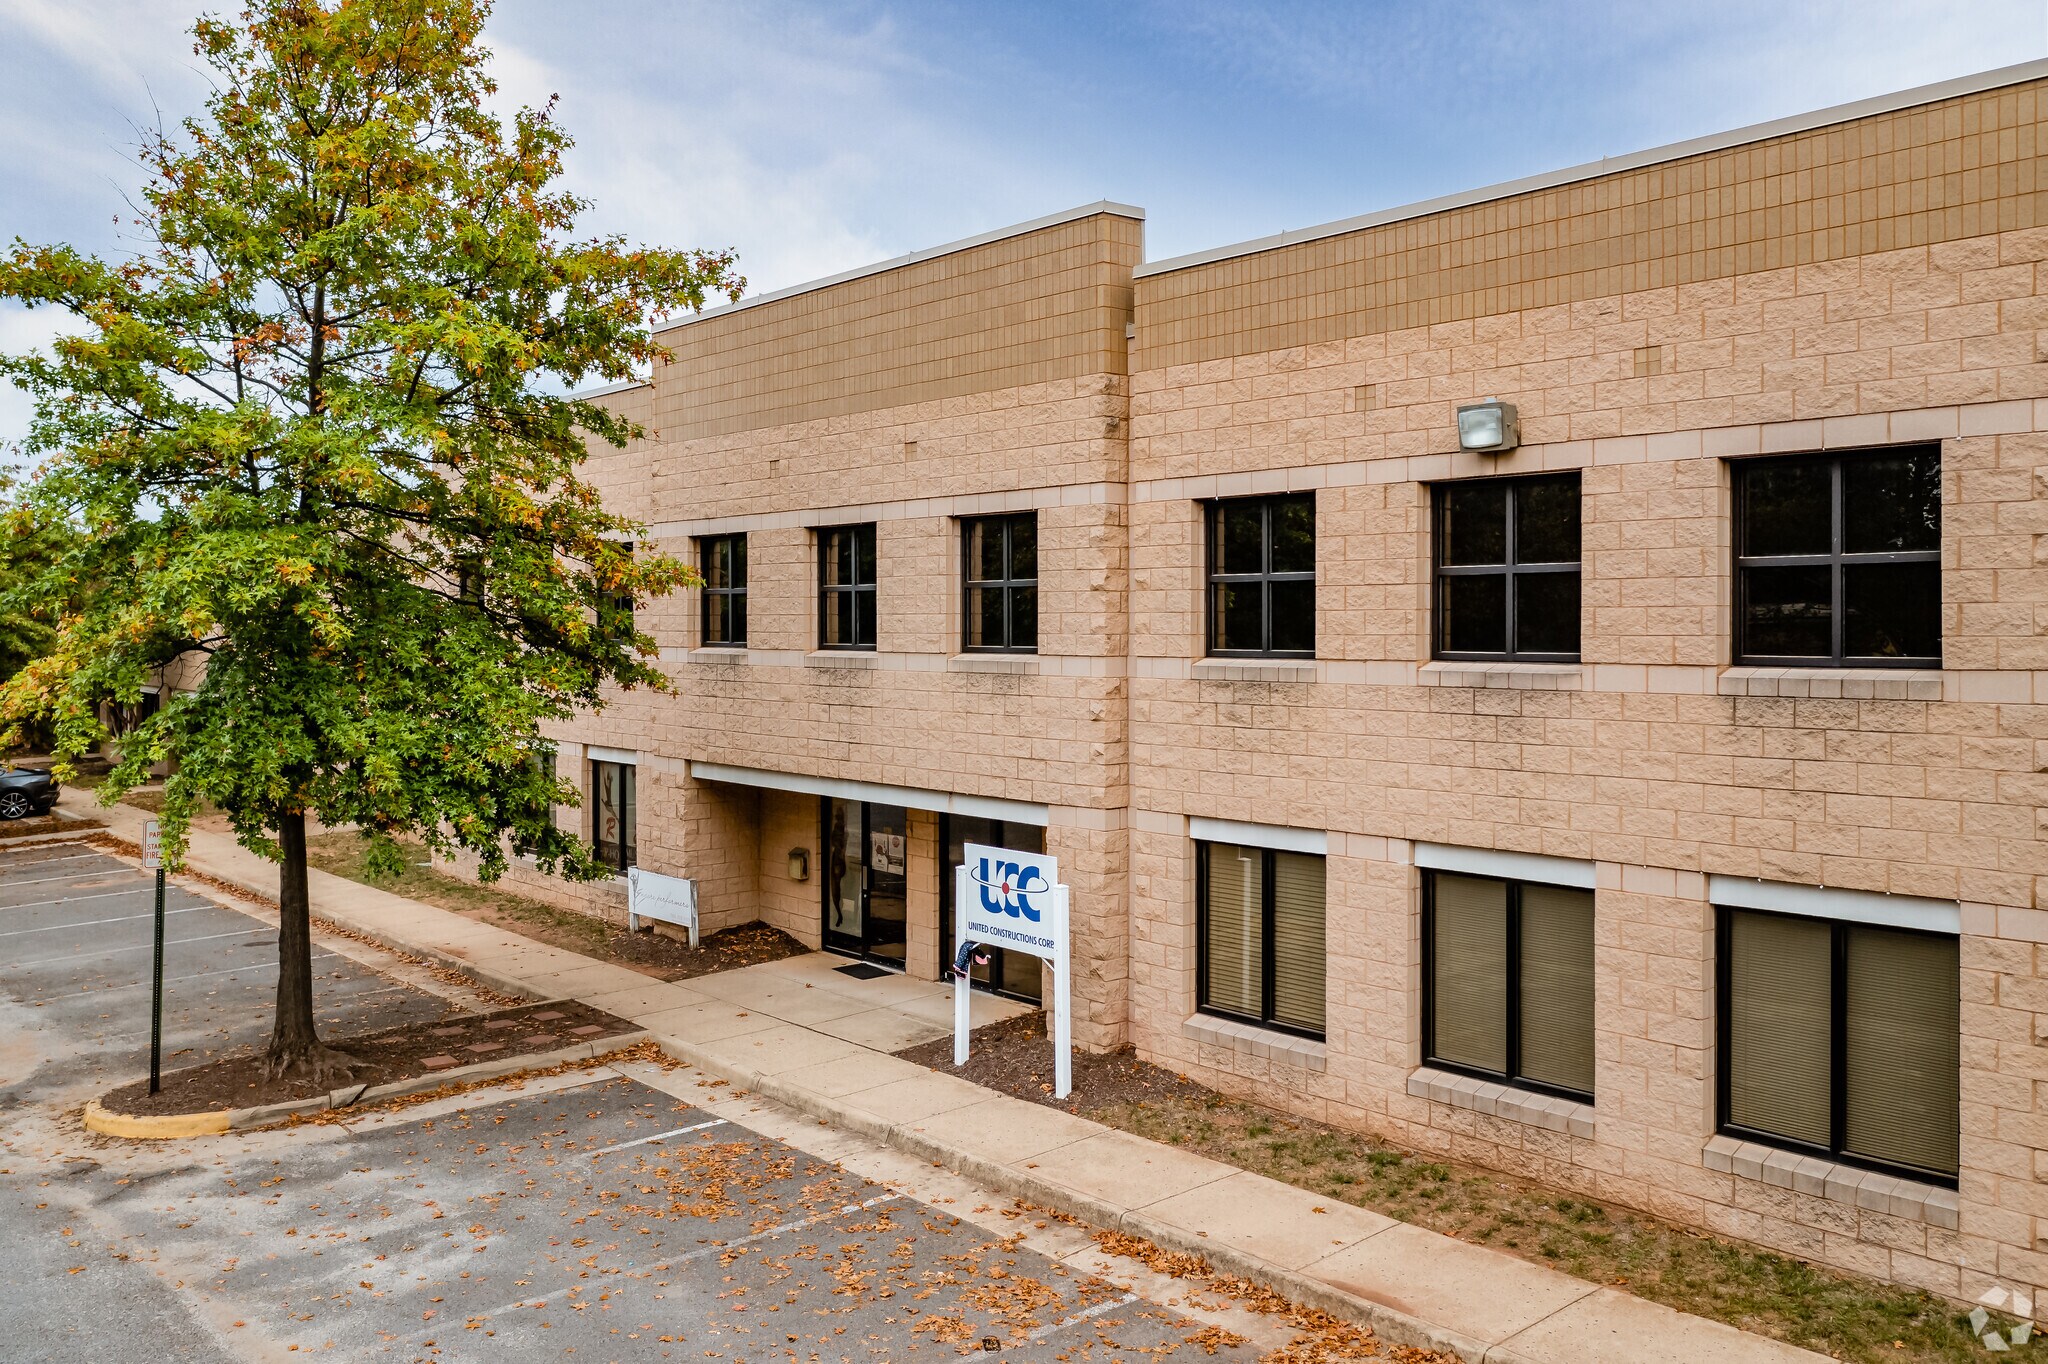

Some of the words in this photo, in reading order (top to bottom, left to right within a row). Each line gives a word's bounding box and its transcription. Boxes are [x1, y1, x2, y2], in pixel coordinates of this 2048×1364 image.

[980, 858, 1040, 922] UCC
[968, 921, 989, 934] UNITED
[989, 926, 1037, 945] CONSTRUCTIONS
